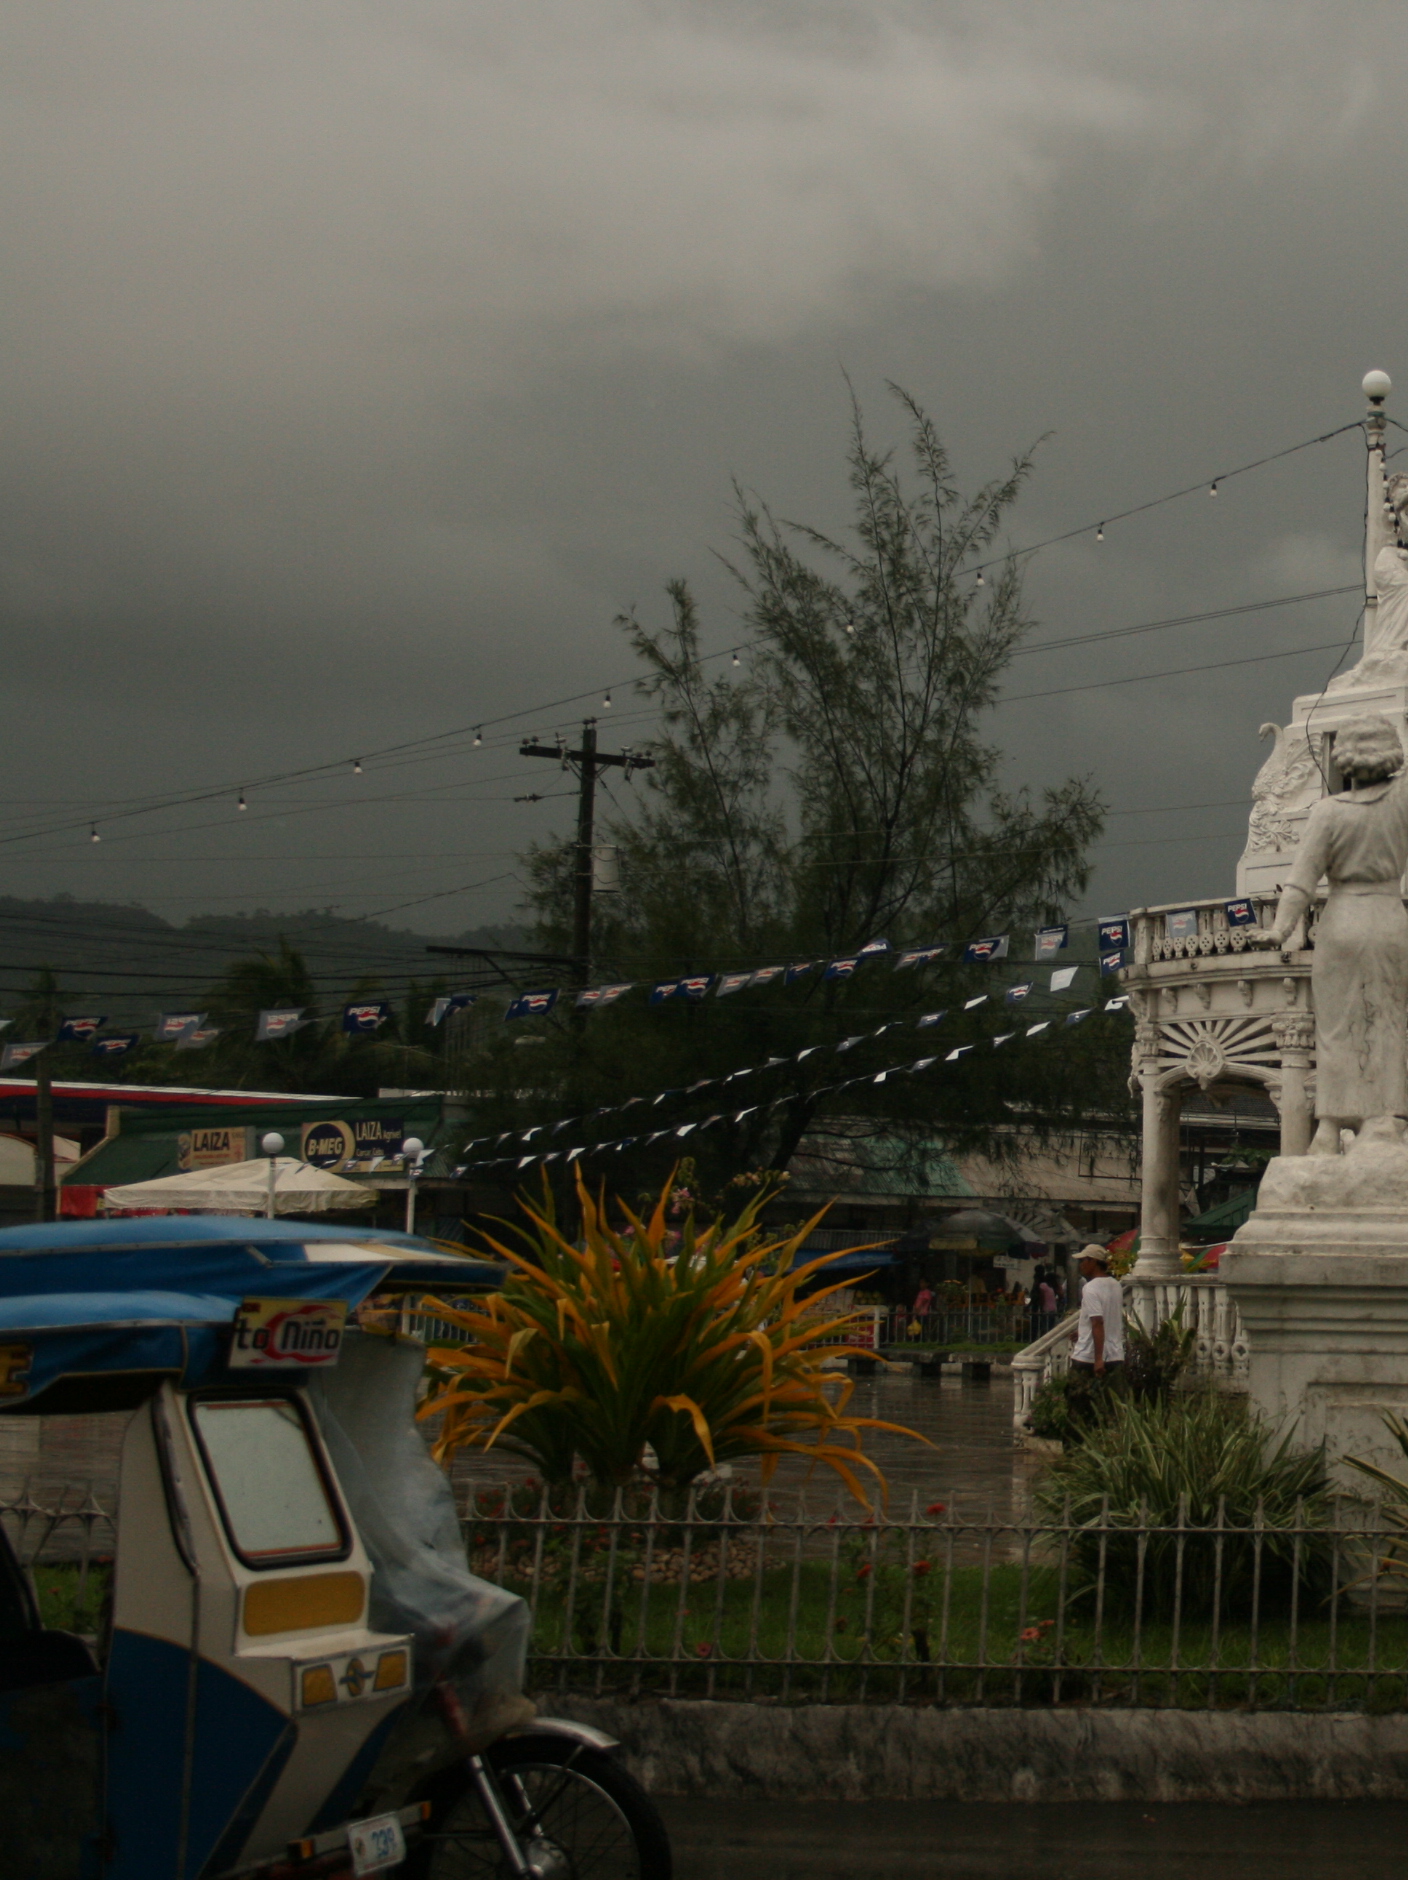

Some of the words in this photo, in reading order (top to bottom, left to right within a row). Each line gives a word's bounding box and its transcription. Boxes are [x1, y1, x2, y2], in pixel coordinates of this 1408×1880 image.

[1227, 903, 1247, 912] PEPSI
[1101, 924, 1122, 935] PEPSI
[349, 1005, 380, 1015] PEPSI
[356, 1121, 382, 1140] LAIZA
[194, 1132, 230, 1151] LAIZA
[281, 1317, 340, 1350] Niño
